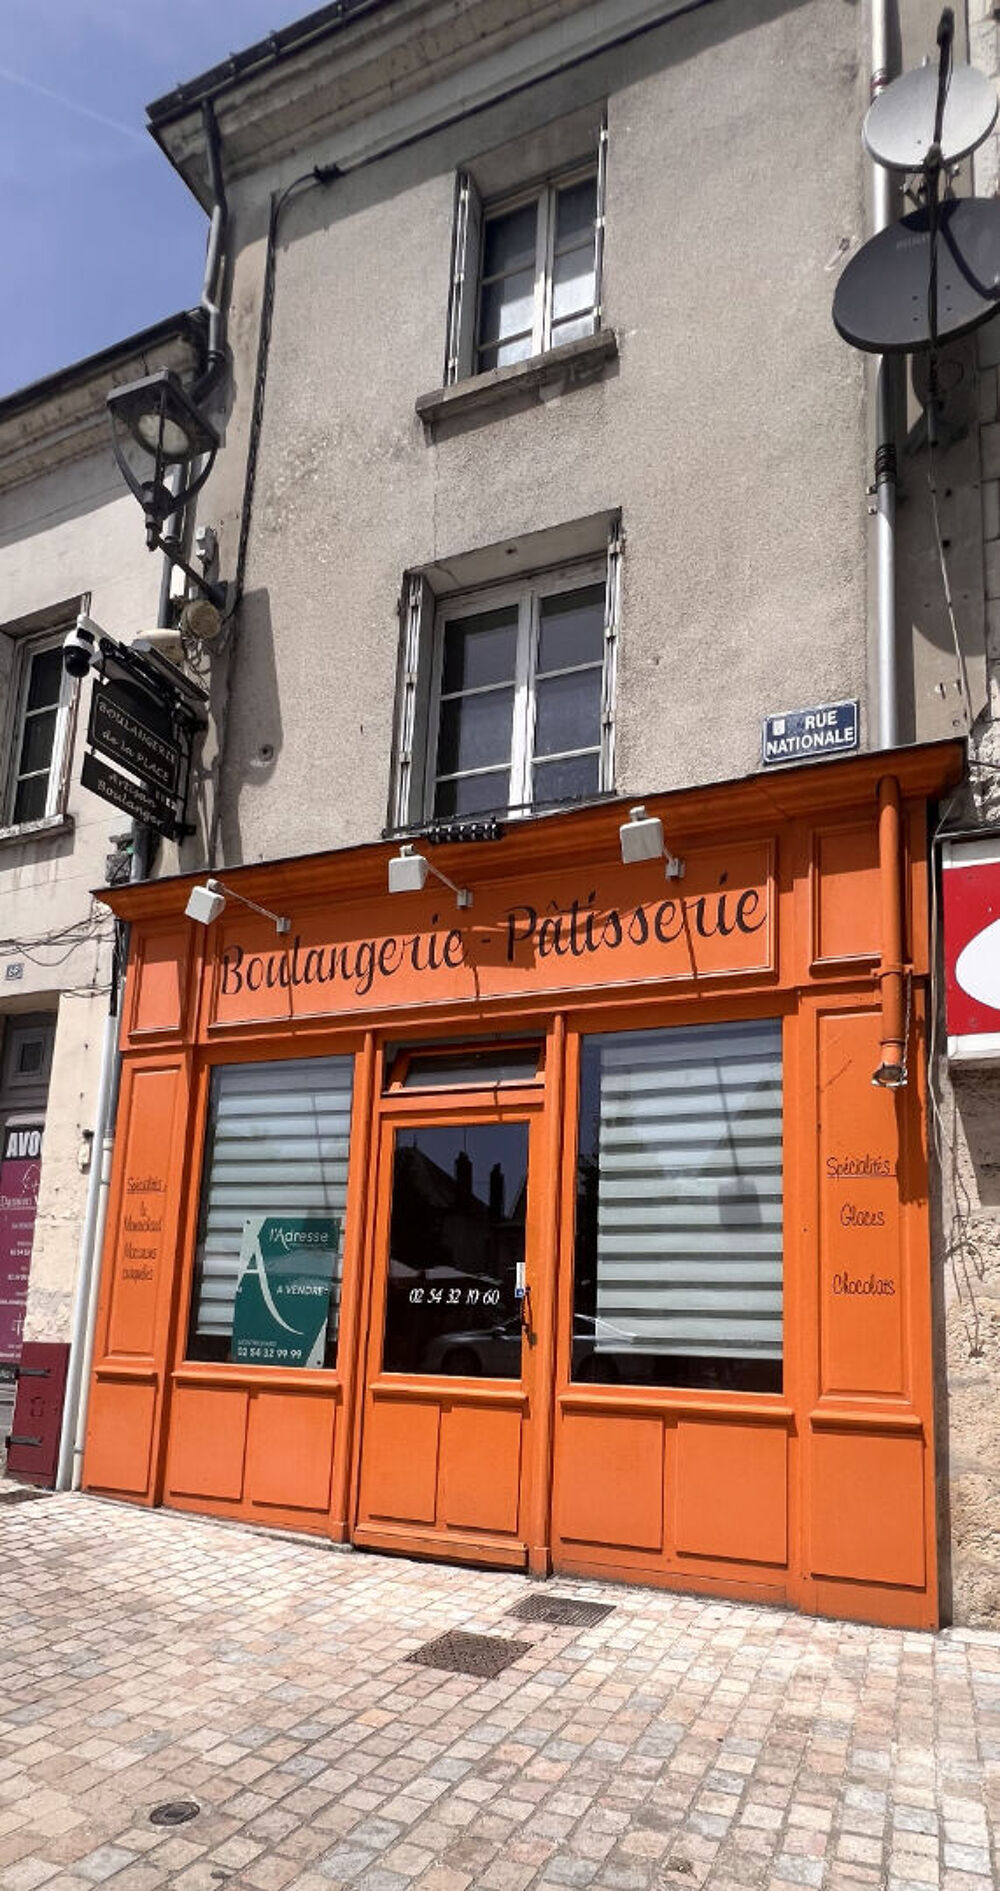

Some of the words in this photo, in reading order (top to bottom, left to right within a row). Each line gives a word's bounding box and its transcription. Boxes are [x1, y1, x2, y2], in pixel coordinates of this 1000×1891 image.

[804, 710, 838, 730] RUE
[766, 726, 855, 755] NATIONALE
[137, 752, 169, 782] PLACE
[221, 913, 468, 996] Boulangerie
[503, 871, 768, 963] Pâtisserie
[826, 1153, 891, 1182] Spécialités
[839, 1201, 886, 1227] Glaces
[409, 1288, 425, 1304] 02
[427, 1288, 444, 1304] 54
[446, 1288, 462, 1304] 32
[465, 1288, 480, 1305] 10
[483, 1289, 501, 1305] 60
[832, 1271, 896, 1296] Chocolats
